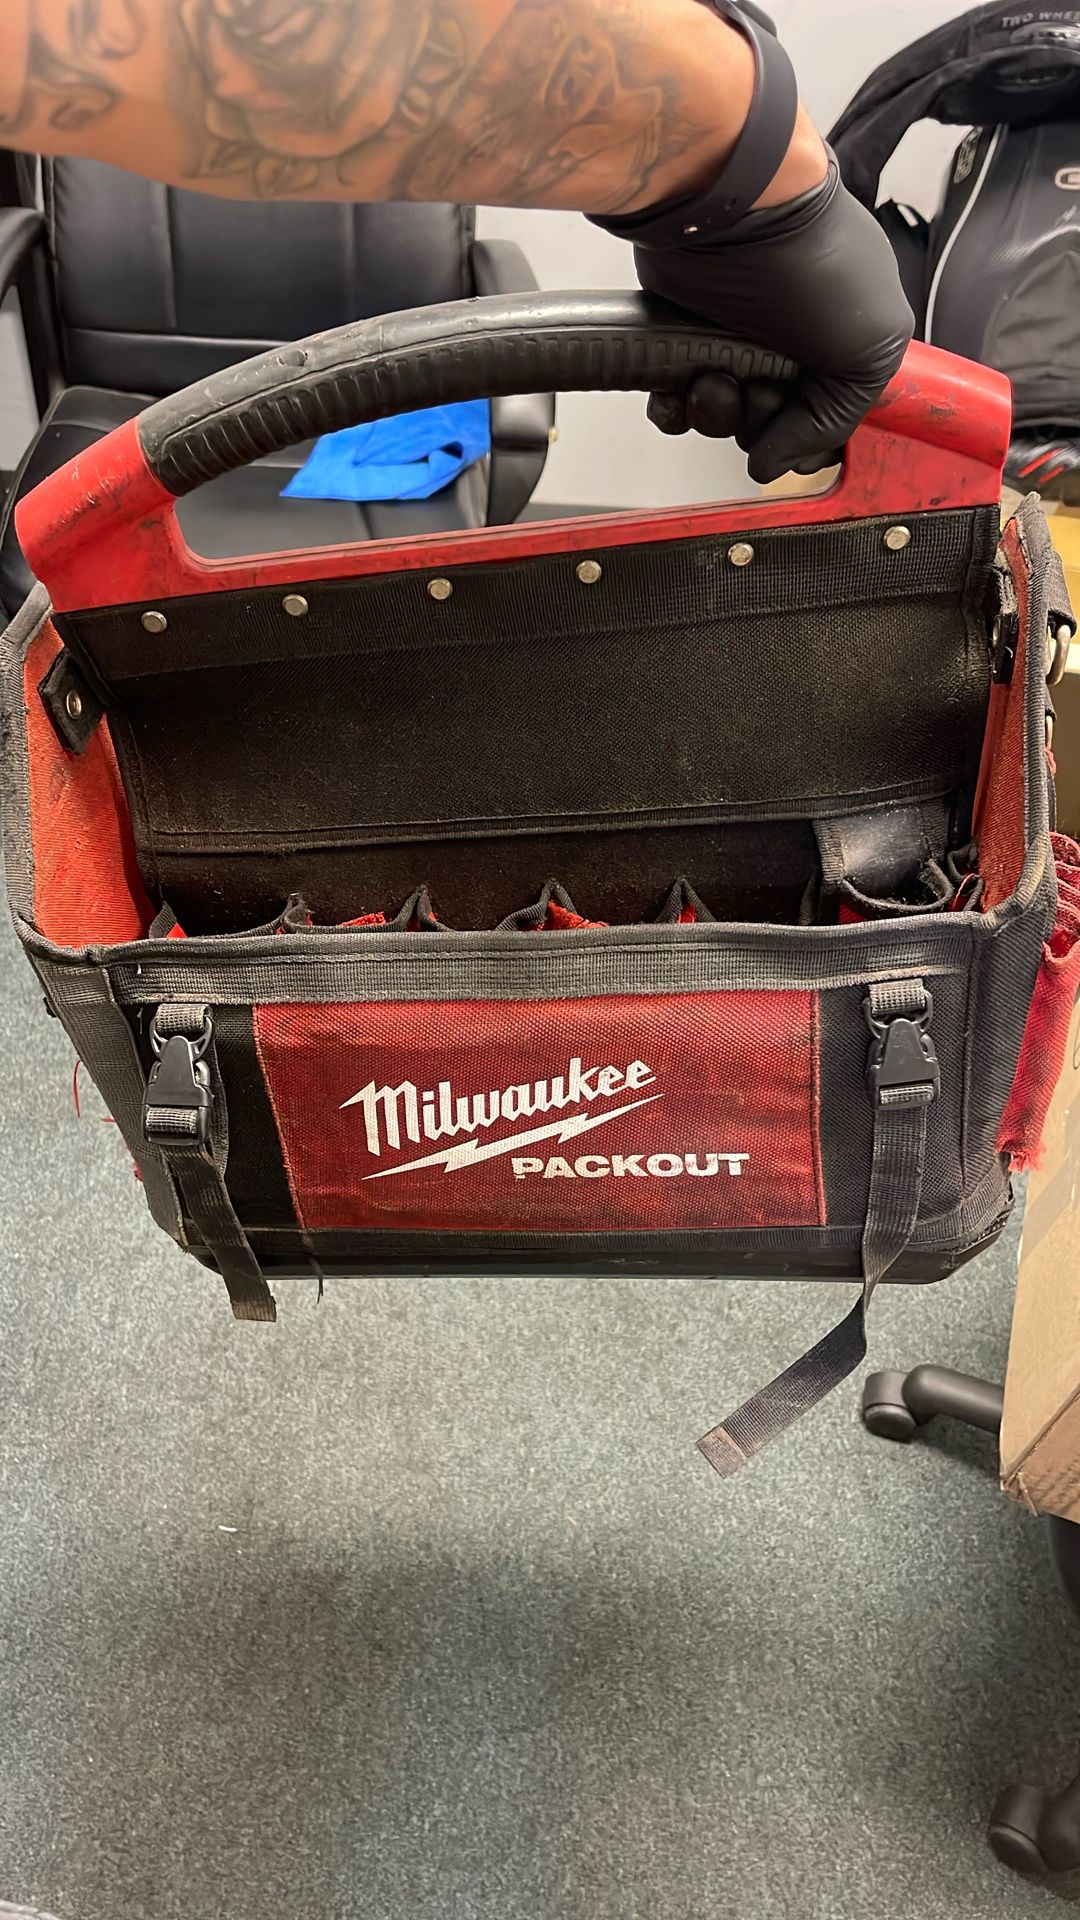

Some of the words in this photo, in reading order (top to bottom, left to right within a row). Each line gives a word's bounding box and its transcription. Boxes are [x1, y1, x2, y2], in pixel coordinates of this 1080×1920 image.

[1001, 12, 1034, 28] TWO
[339, 1057, 657, 1156] Milwaukee
[511, 1152, 751, 1179] PACKOUT
